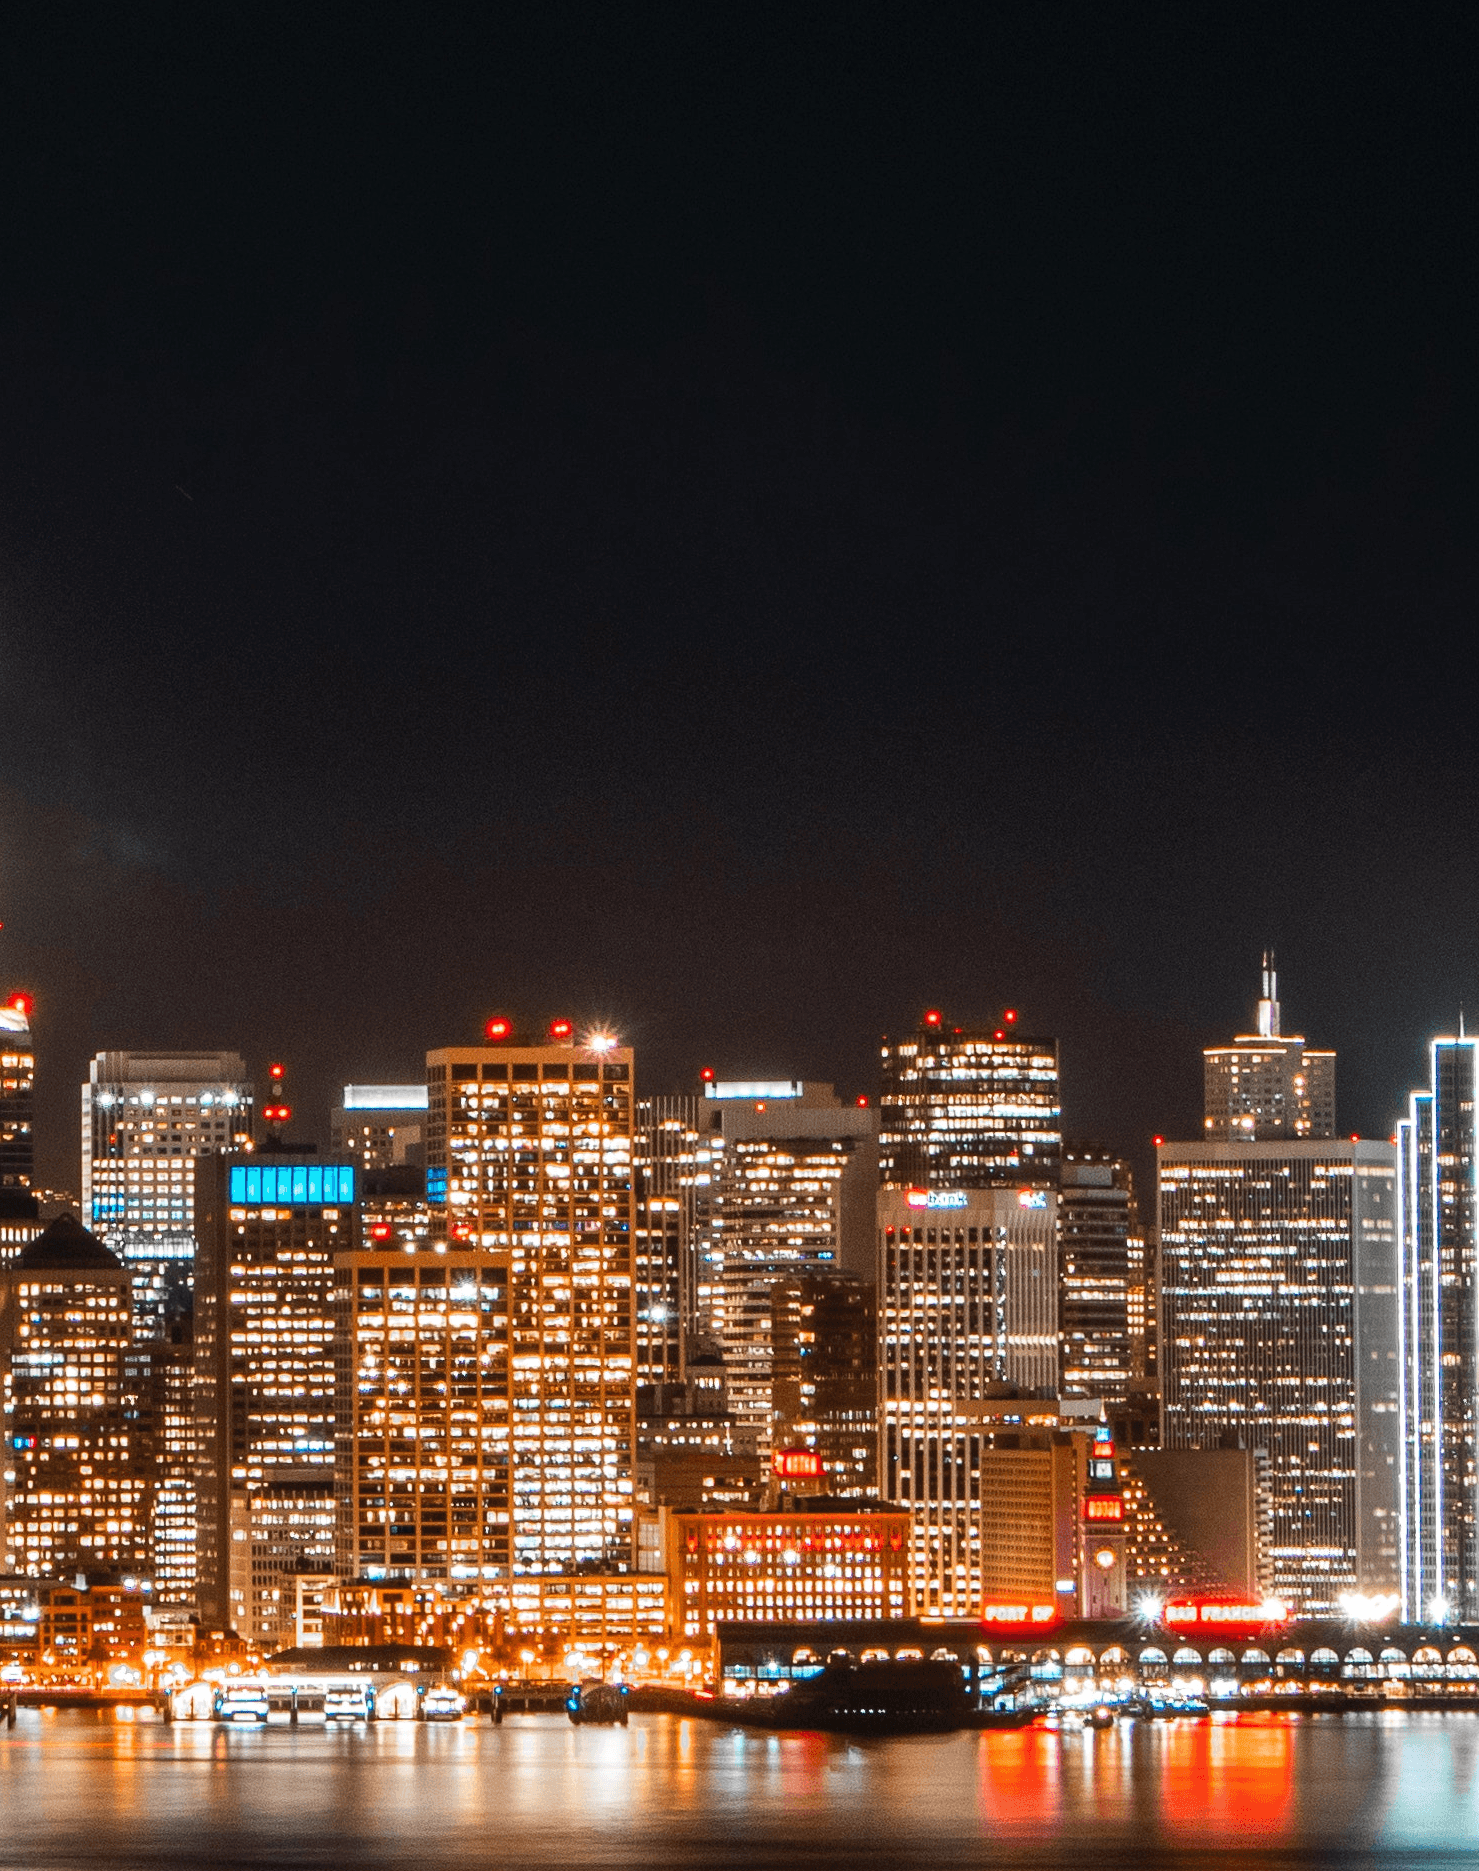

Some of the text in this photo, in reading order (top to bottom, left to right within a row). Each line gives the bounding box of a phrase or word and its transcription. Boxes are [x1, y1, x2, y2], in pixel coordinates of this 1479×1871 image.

[985, 1606, 1054, 1621] PORT OF
[1166, 1606, 1287, 1621] SAN FRANCI
